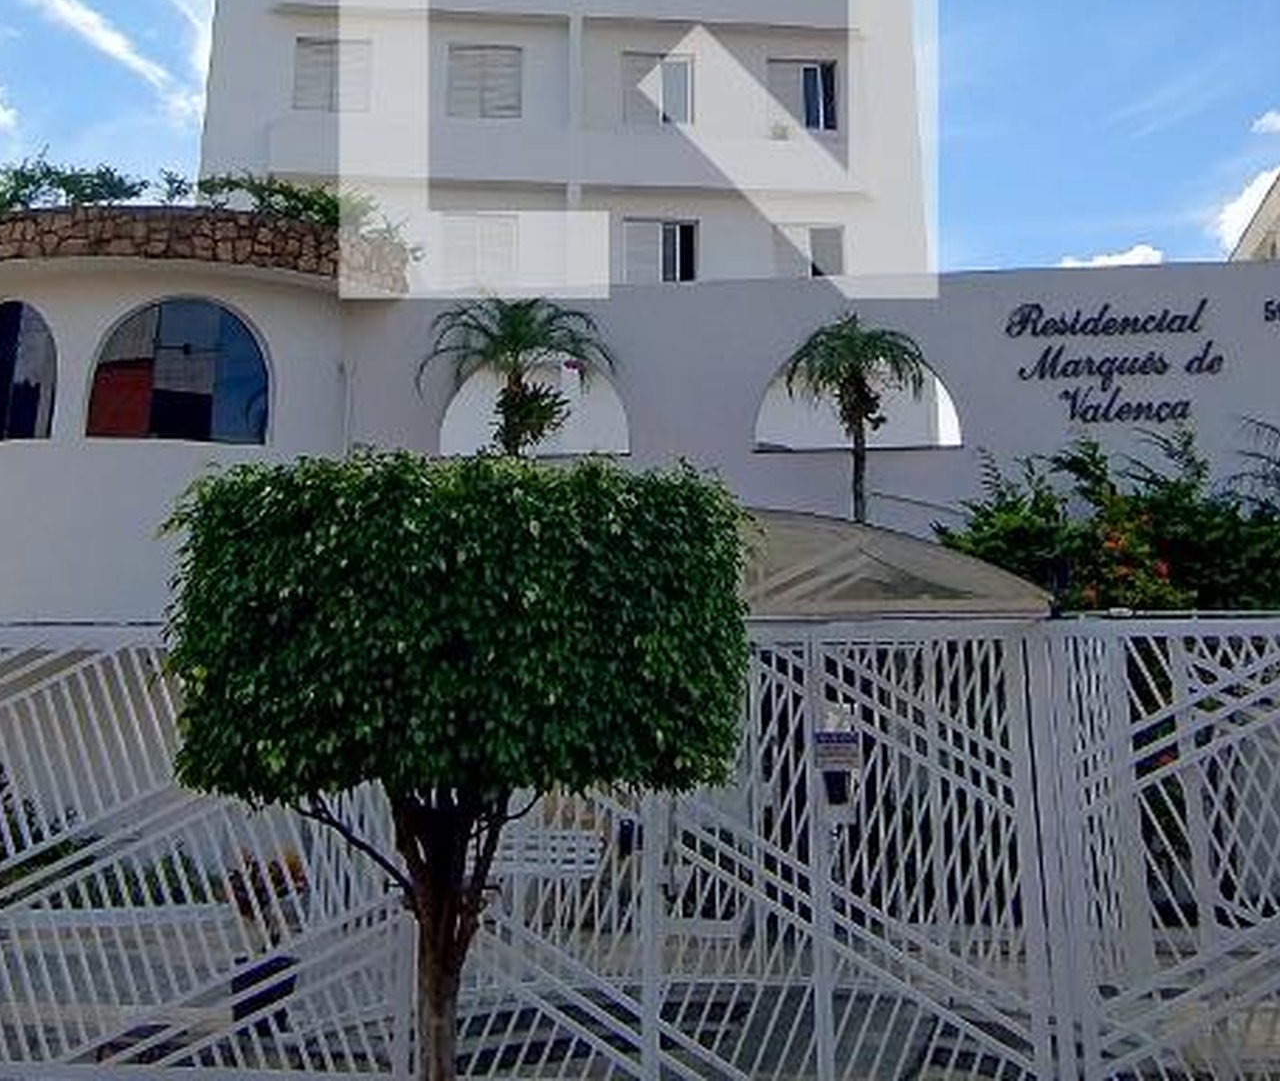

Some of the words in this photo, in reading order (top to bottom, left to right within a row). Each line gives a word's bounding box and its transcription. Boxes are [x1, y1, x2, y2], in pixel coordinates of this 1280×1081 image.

[1004, 298, 1208, 338] Residencial
[1017, 343, 1171, 391] Marquês
[1184, 340, 1224, 374] de
[1059, 385, 1191, 423] Valença
